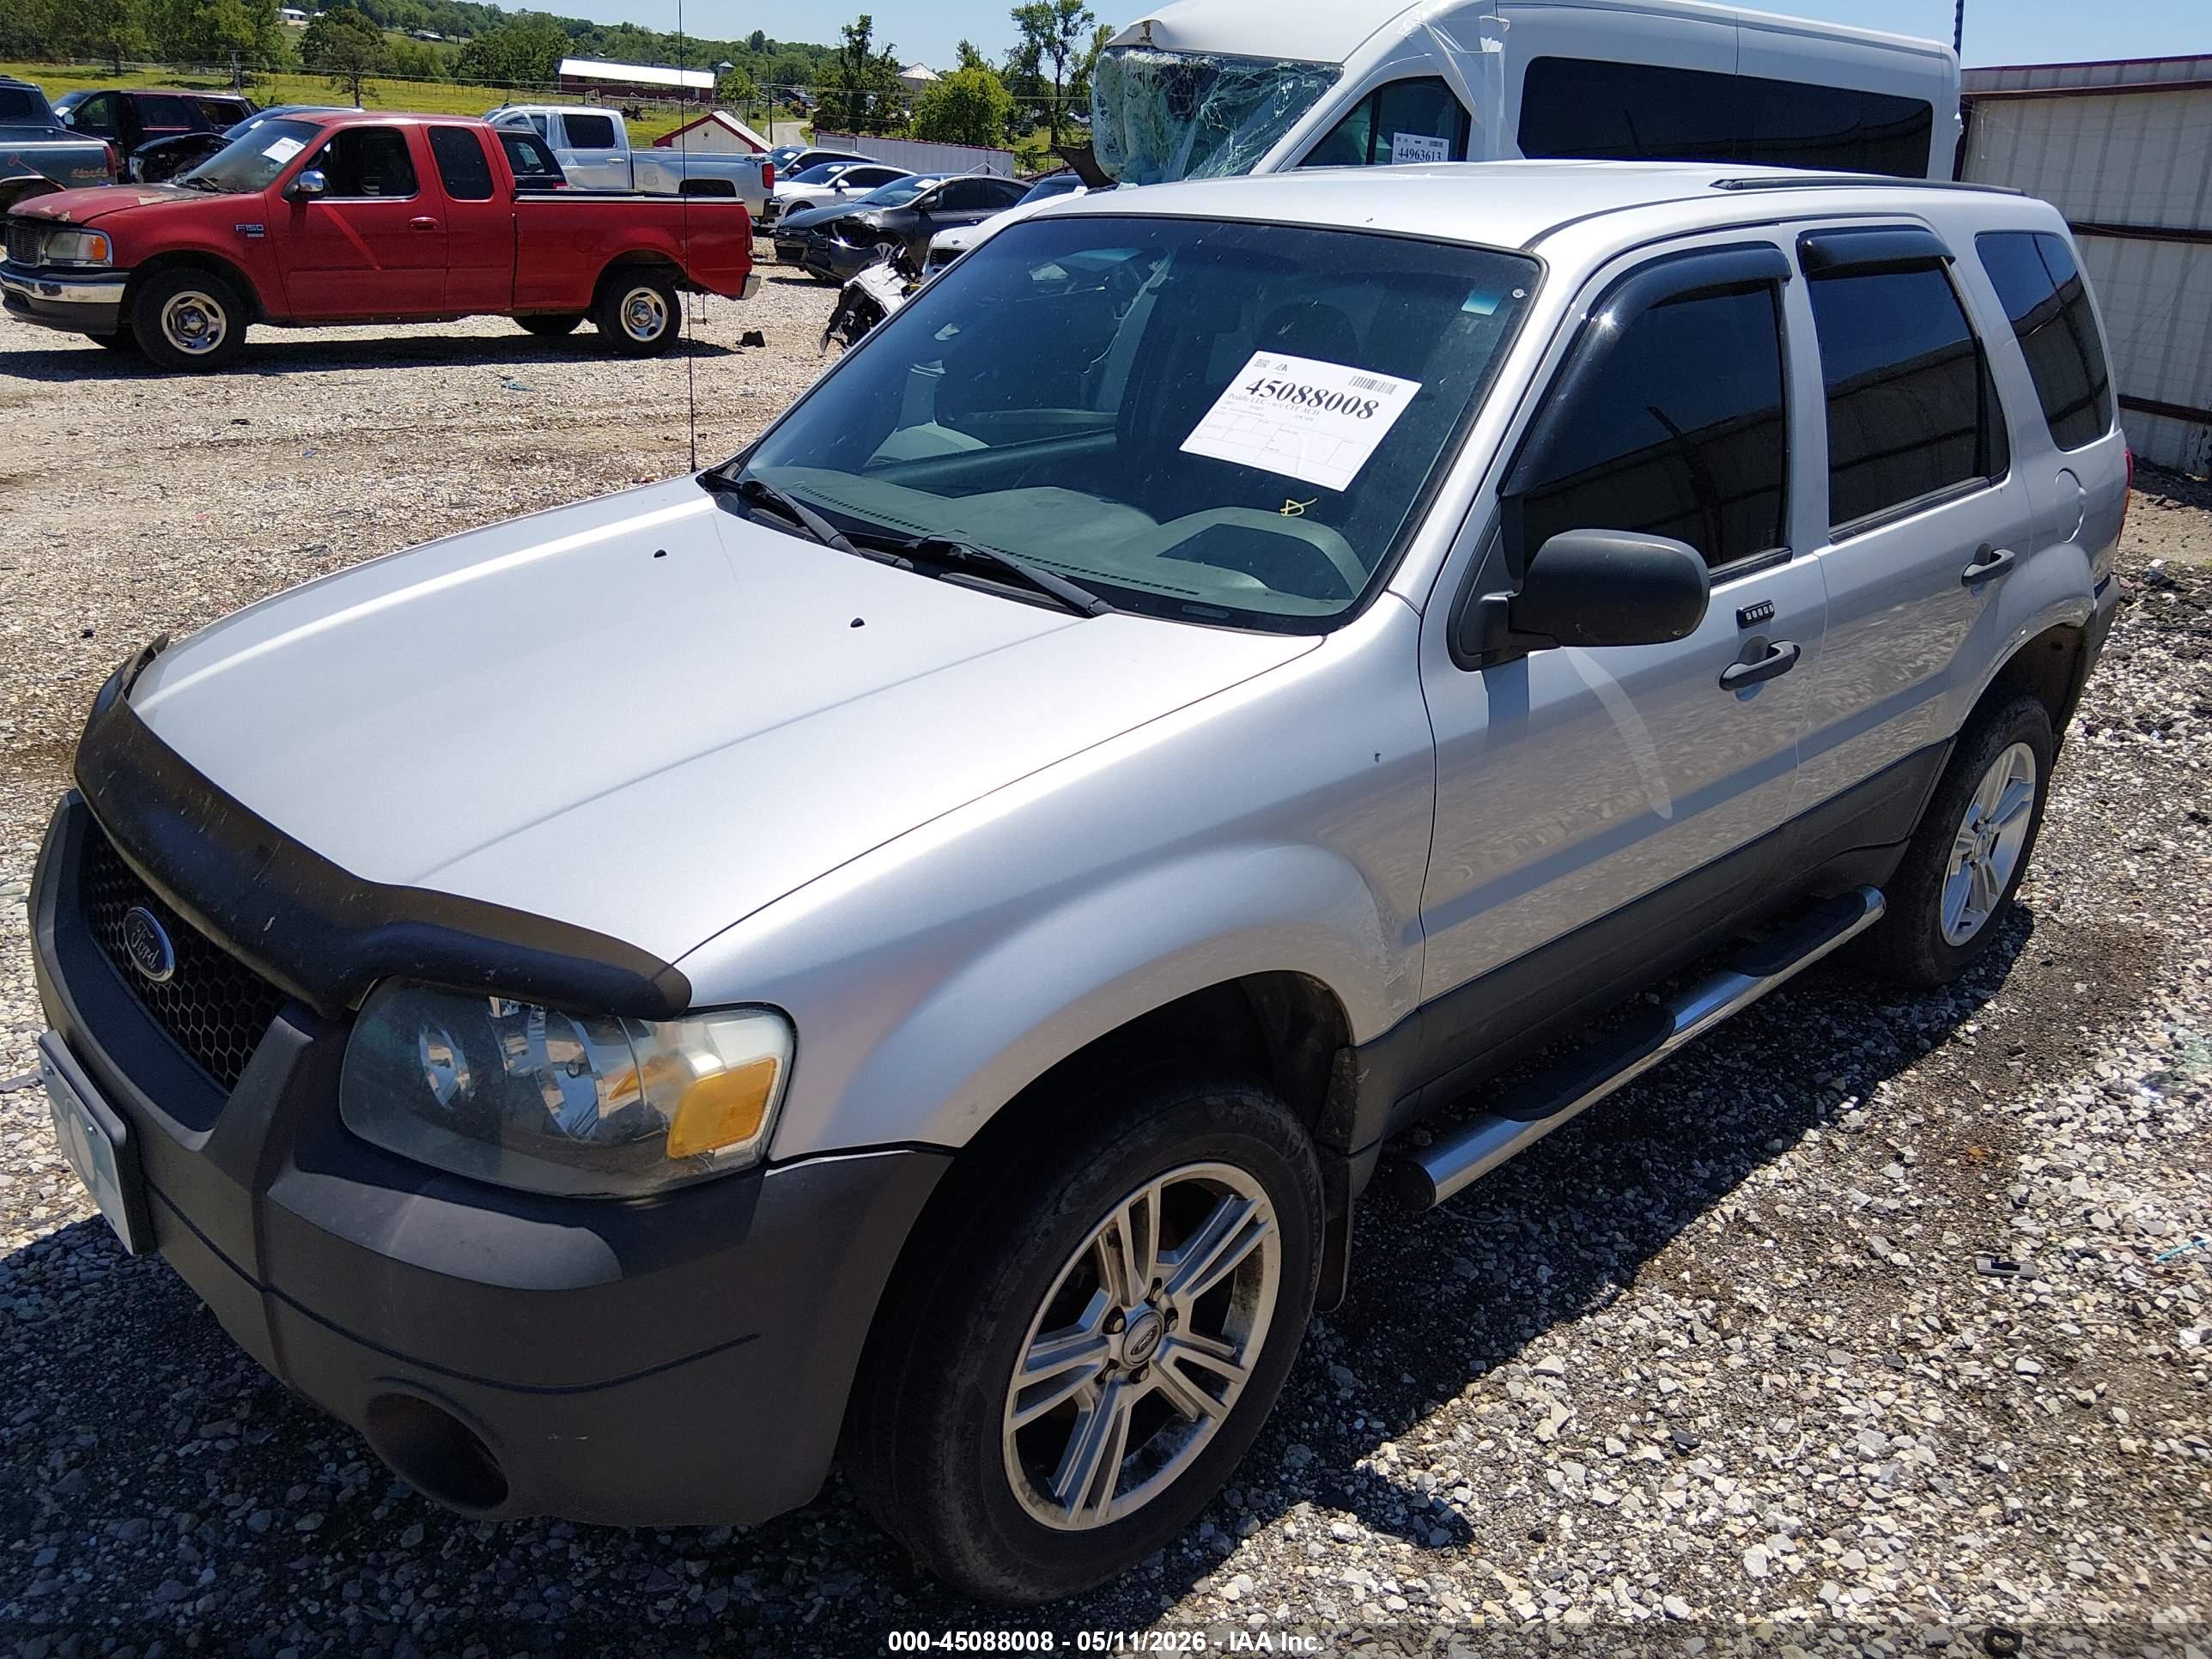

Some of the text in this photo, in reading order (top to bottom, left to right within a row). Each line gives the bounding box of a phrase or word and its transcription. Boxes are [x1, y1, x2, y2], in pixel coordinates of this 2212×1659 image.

[1398, 147, 1441, 162] 44963613
[1245, 378, 1379, 419] 45088008
[131, 920, 160, 969] Ford
